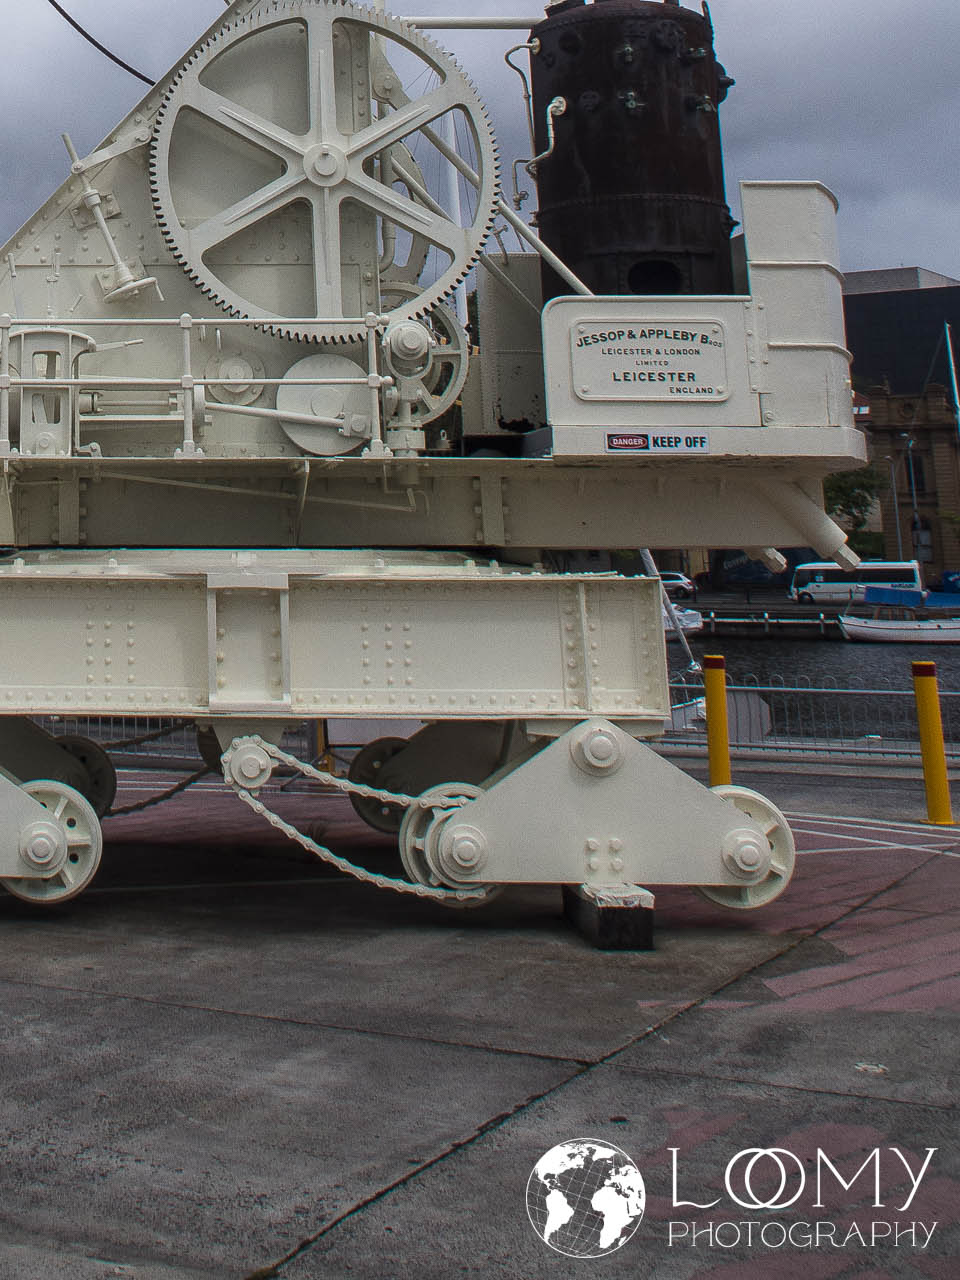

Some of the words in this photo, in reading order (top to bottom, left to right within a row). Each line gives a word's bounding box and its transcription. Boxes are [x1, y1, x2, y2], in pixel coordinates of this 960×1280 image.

[576, 330, 625, 348] JESSOP
[627, 330, 637, 340] &
[639, 329, 698, 342] APPLEBY
[612, 371, 696, 382] LEICESTER
[669, 386, 713, 394] ENGLAND
[612, 437, 644, 446] DANGER
[652, 435, 681, 448] KEEP
[684, 436, 707, 448] OFF
